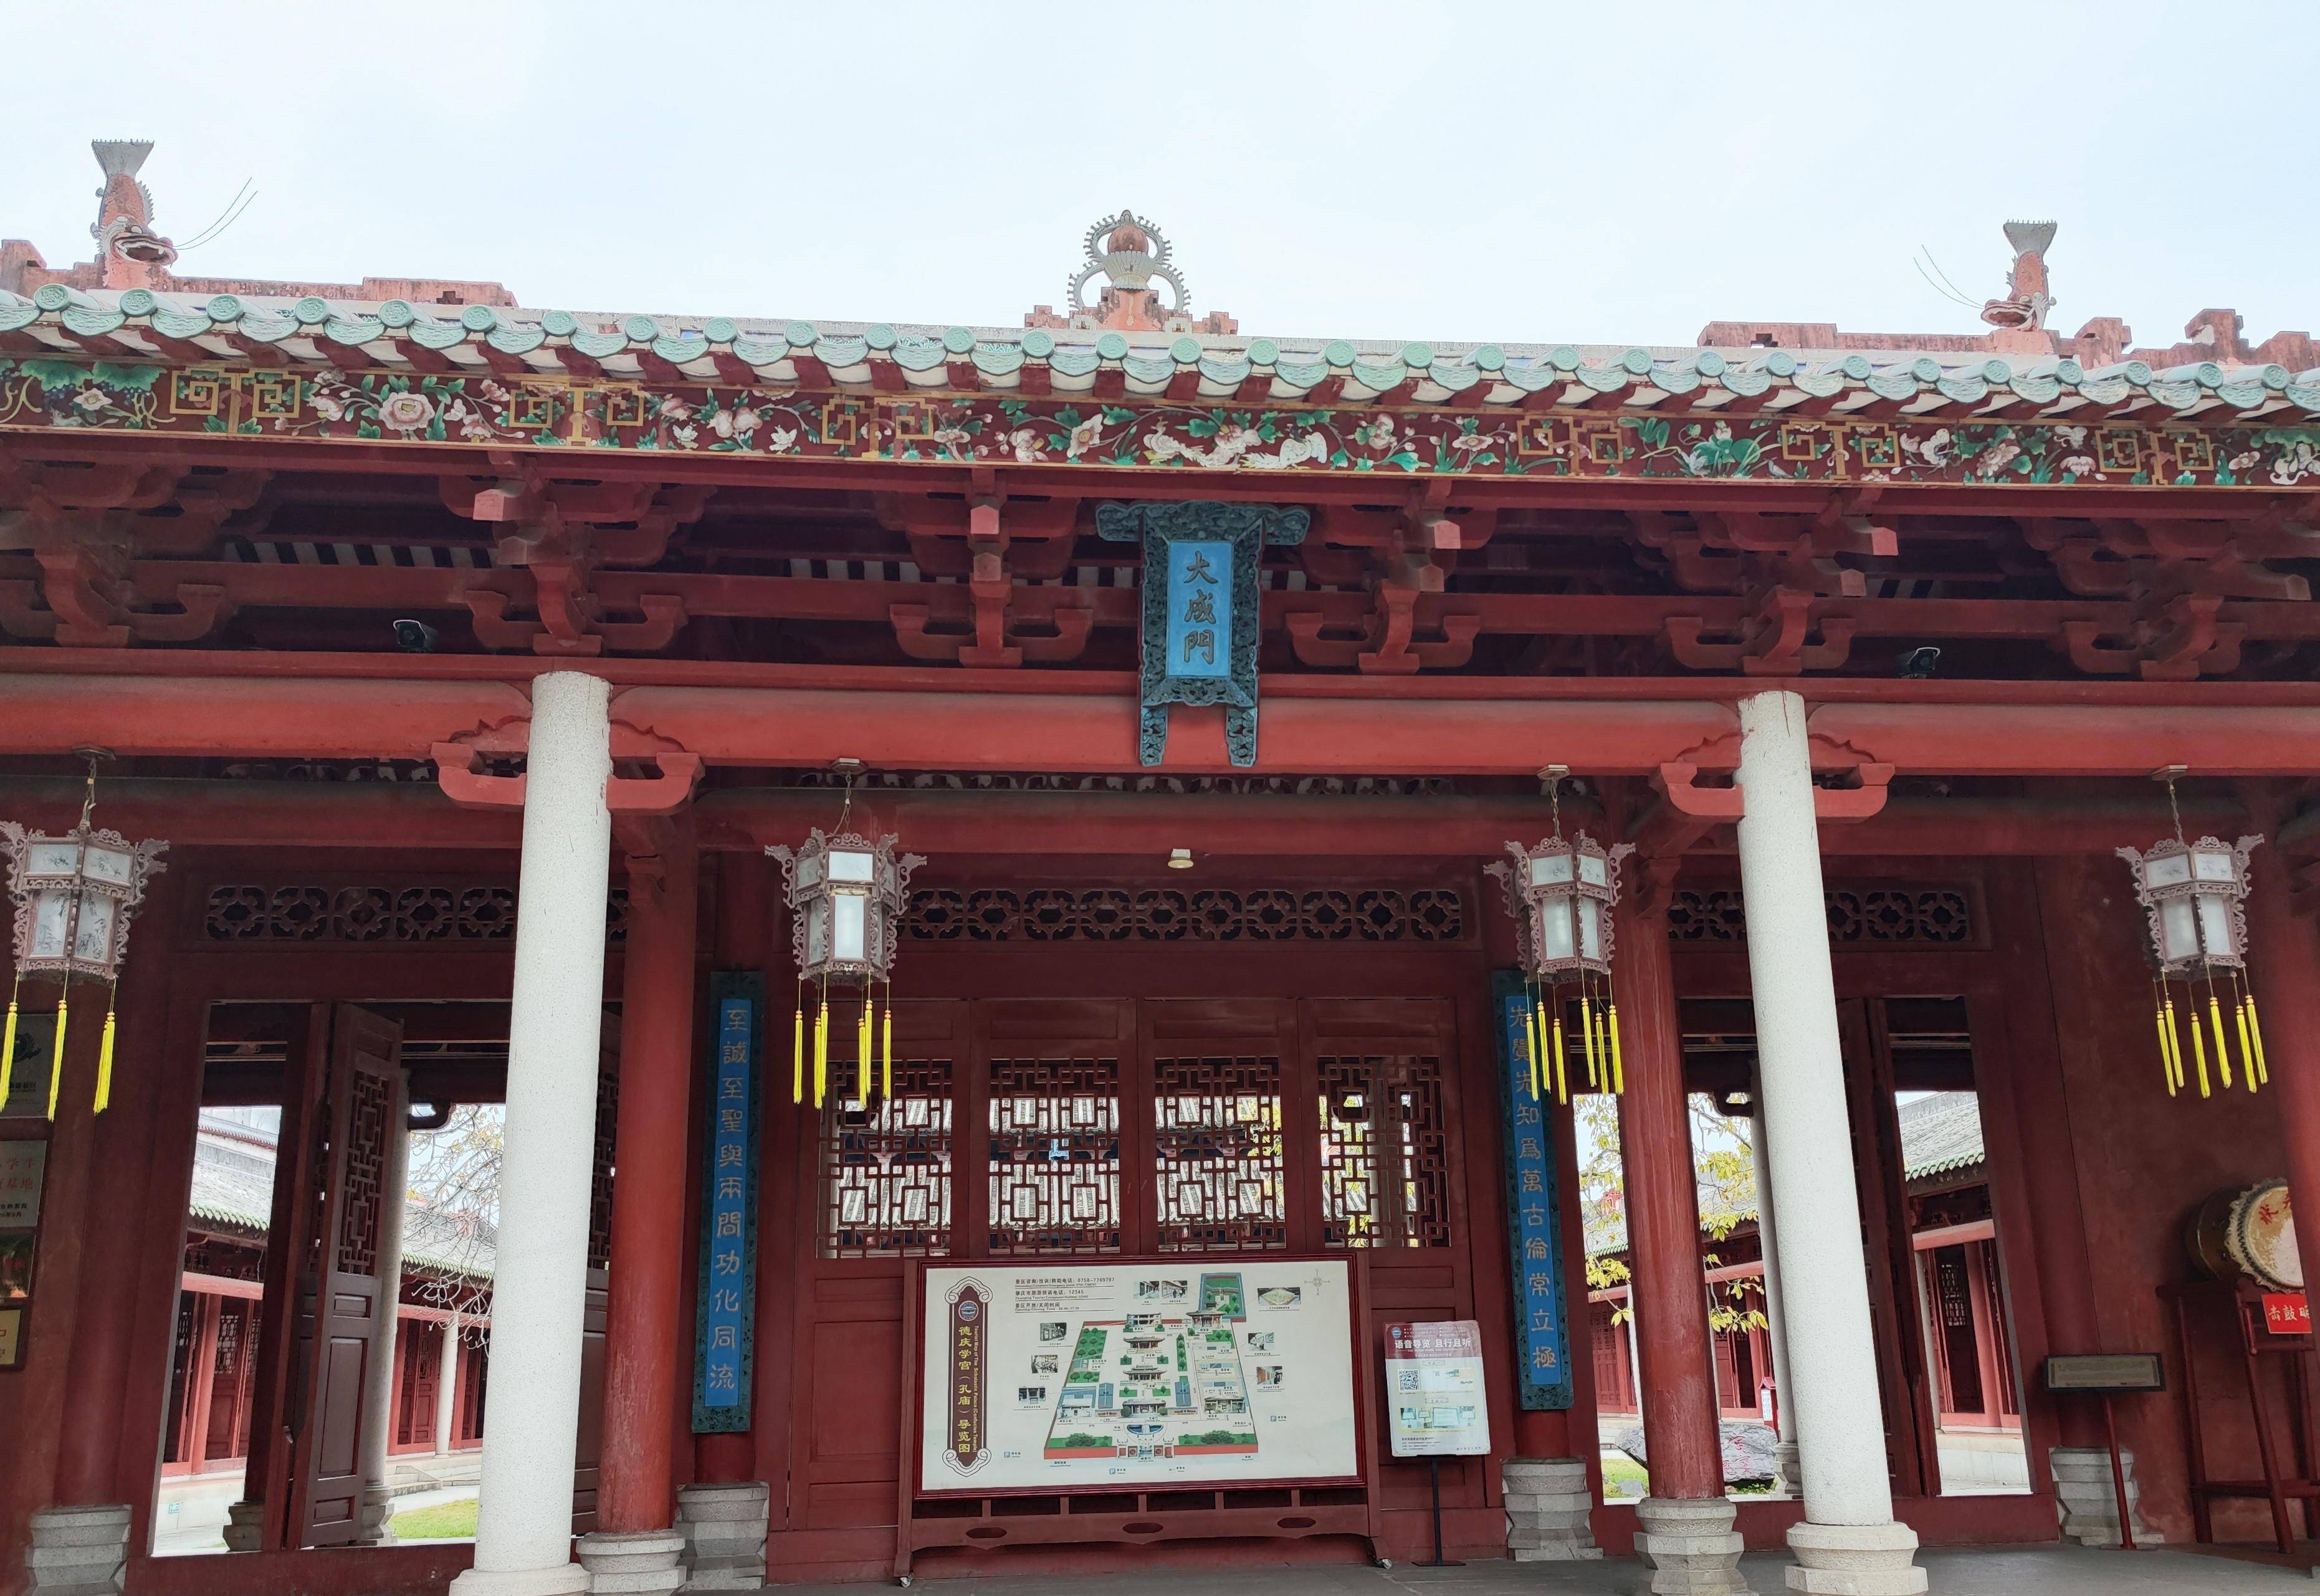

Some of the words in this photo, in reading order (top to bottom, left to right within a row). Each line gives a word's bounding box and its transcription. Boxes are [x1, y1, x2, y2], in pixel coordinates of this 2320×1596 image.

[1395, 1339, 1431, 1349] 语音导览
[1434, 1338, 1471, 1348] 且行且听
